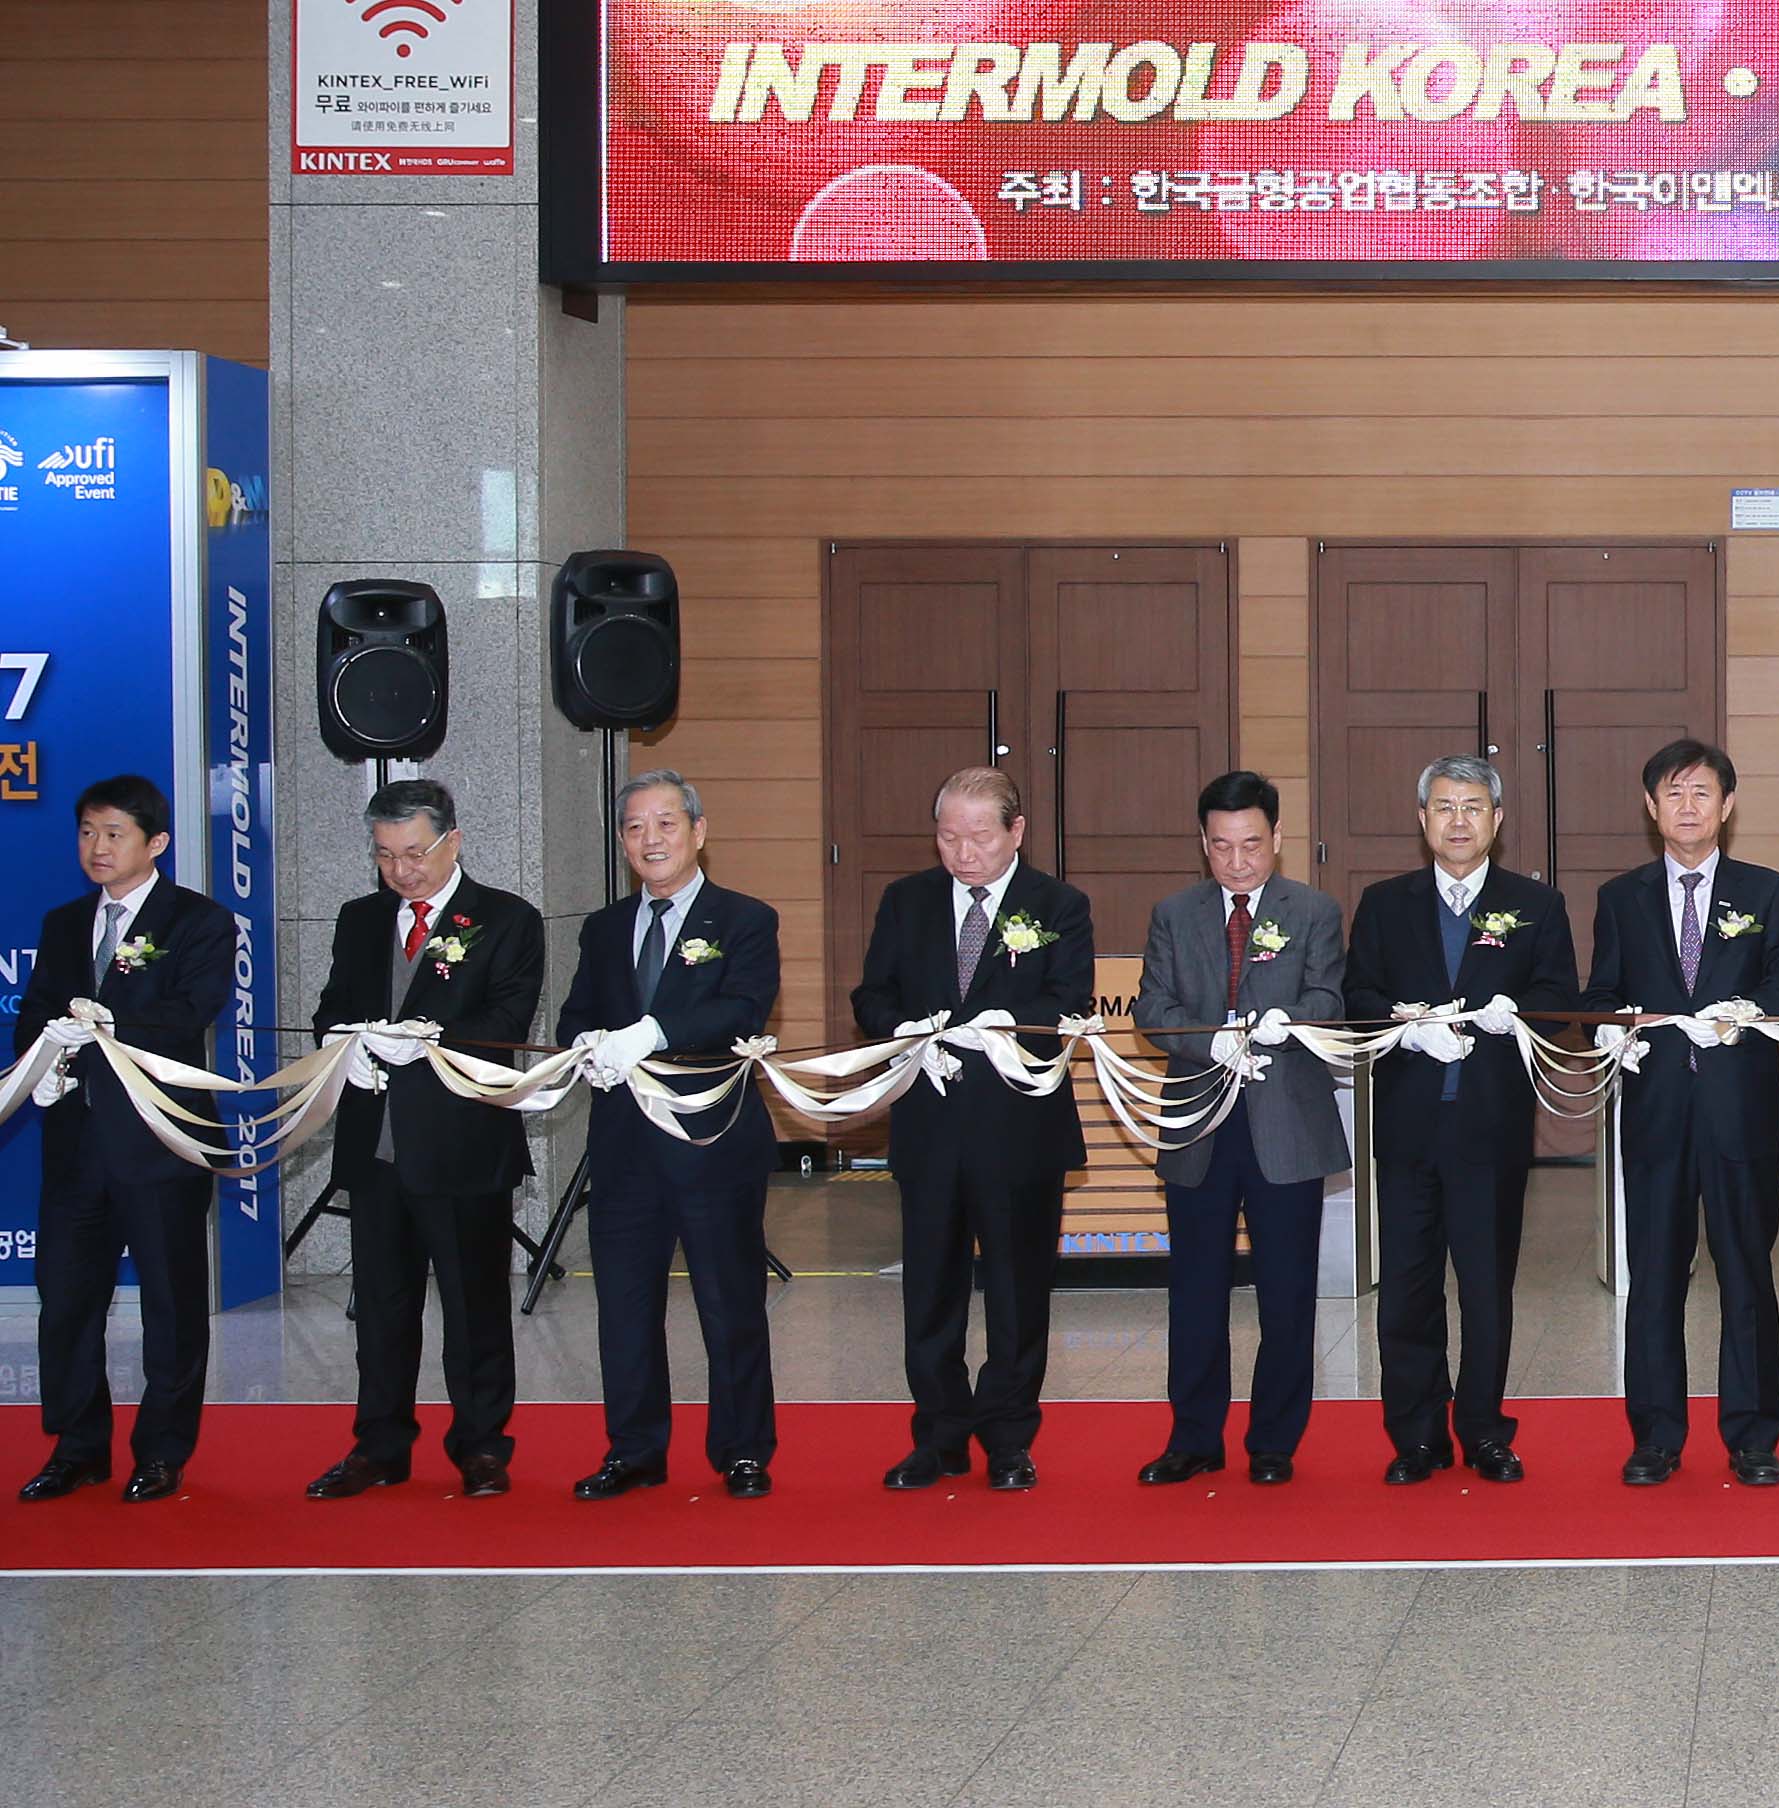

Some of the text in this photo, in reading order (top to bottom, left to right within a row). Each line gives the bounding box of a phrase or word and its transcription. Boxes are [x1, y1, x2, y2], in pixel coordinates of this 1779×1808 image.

[707, 41, 1308, 122] INTERMOLD
[1328, 42, 1688, 122] KOREA
[315, 94, 492, 114] 무료 와이파이를 편하게 즐기세요
[300, 152, 393, 171] KINTEX
[997, 169, 1082, 213] 주최
[75, 437, 115, 469] ufi
[44, 471, 115, 488] Approved
[75, 485, 116, 500] Event
[228, 585, 259, 1222] INTERMOLD KOREA 2017
[1063, 1232, 1170, 1254] KINTEX
